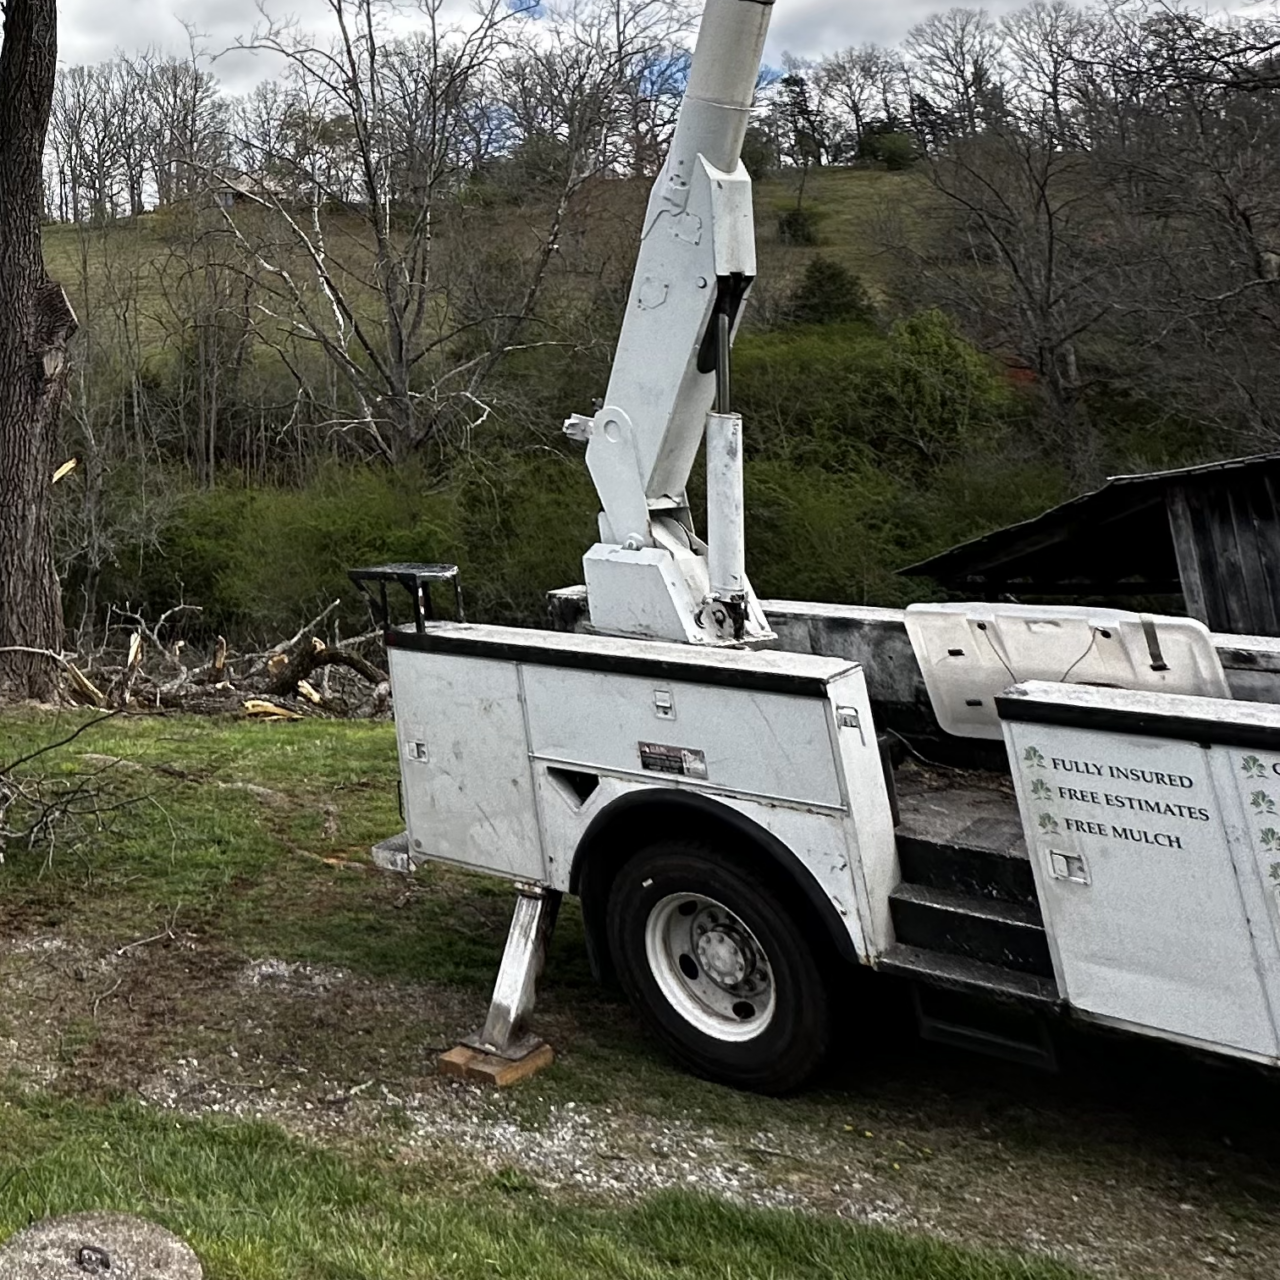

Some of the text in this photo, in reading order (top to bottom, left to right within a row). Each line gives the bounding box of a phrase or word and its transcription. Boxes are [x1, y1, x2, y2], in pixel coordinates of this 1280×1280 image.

[1051, 757, 1194, 789] FULLY INSURED
[1058, 786, 1210, 821] FREE ESTIMATES
[1064, 818, 1184, 849] FREE MULCH
